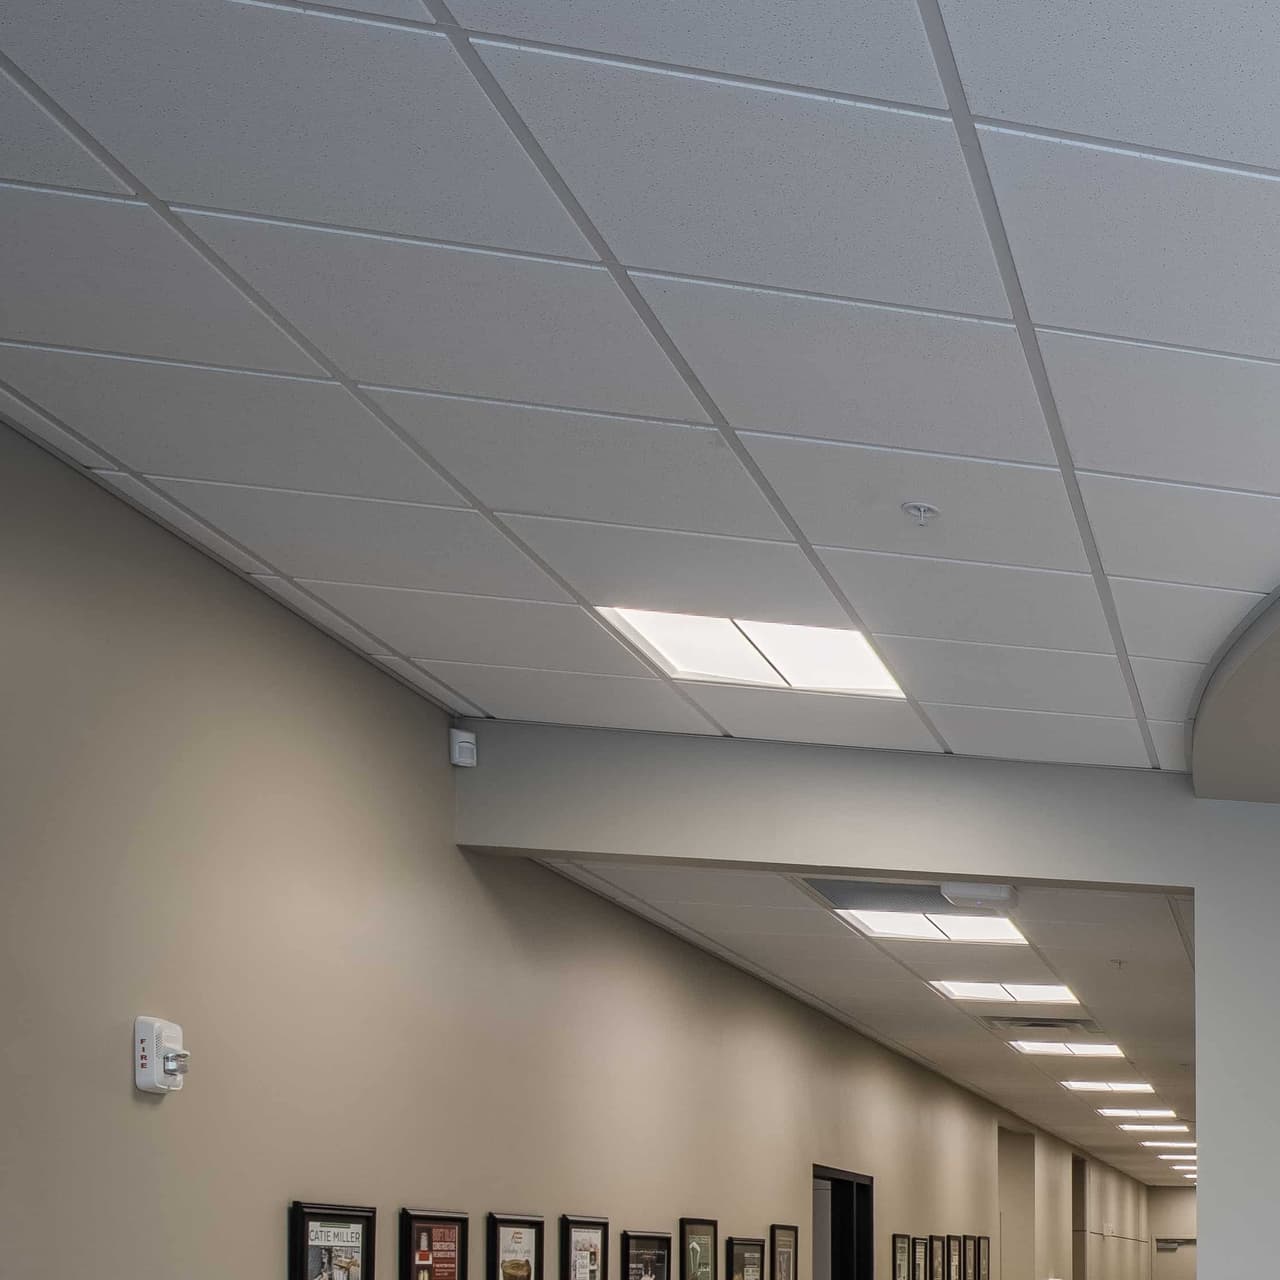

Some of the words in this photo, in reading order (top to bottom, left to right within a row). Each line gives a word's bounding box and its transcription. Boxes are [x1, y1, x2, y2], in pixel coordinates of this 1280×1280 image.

[140, 1039, 148, 1069] FIRE
[310, 1230, 332, 1242] CATIE
[333, 1231, 361, 1243] MILLER
